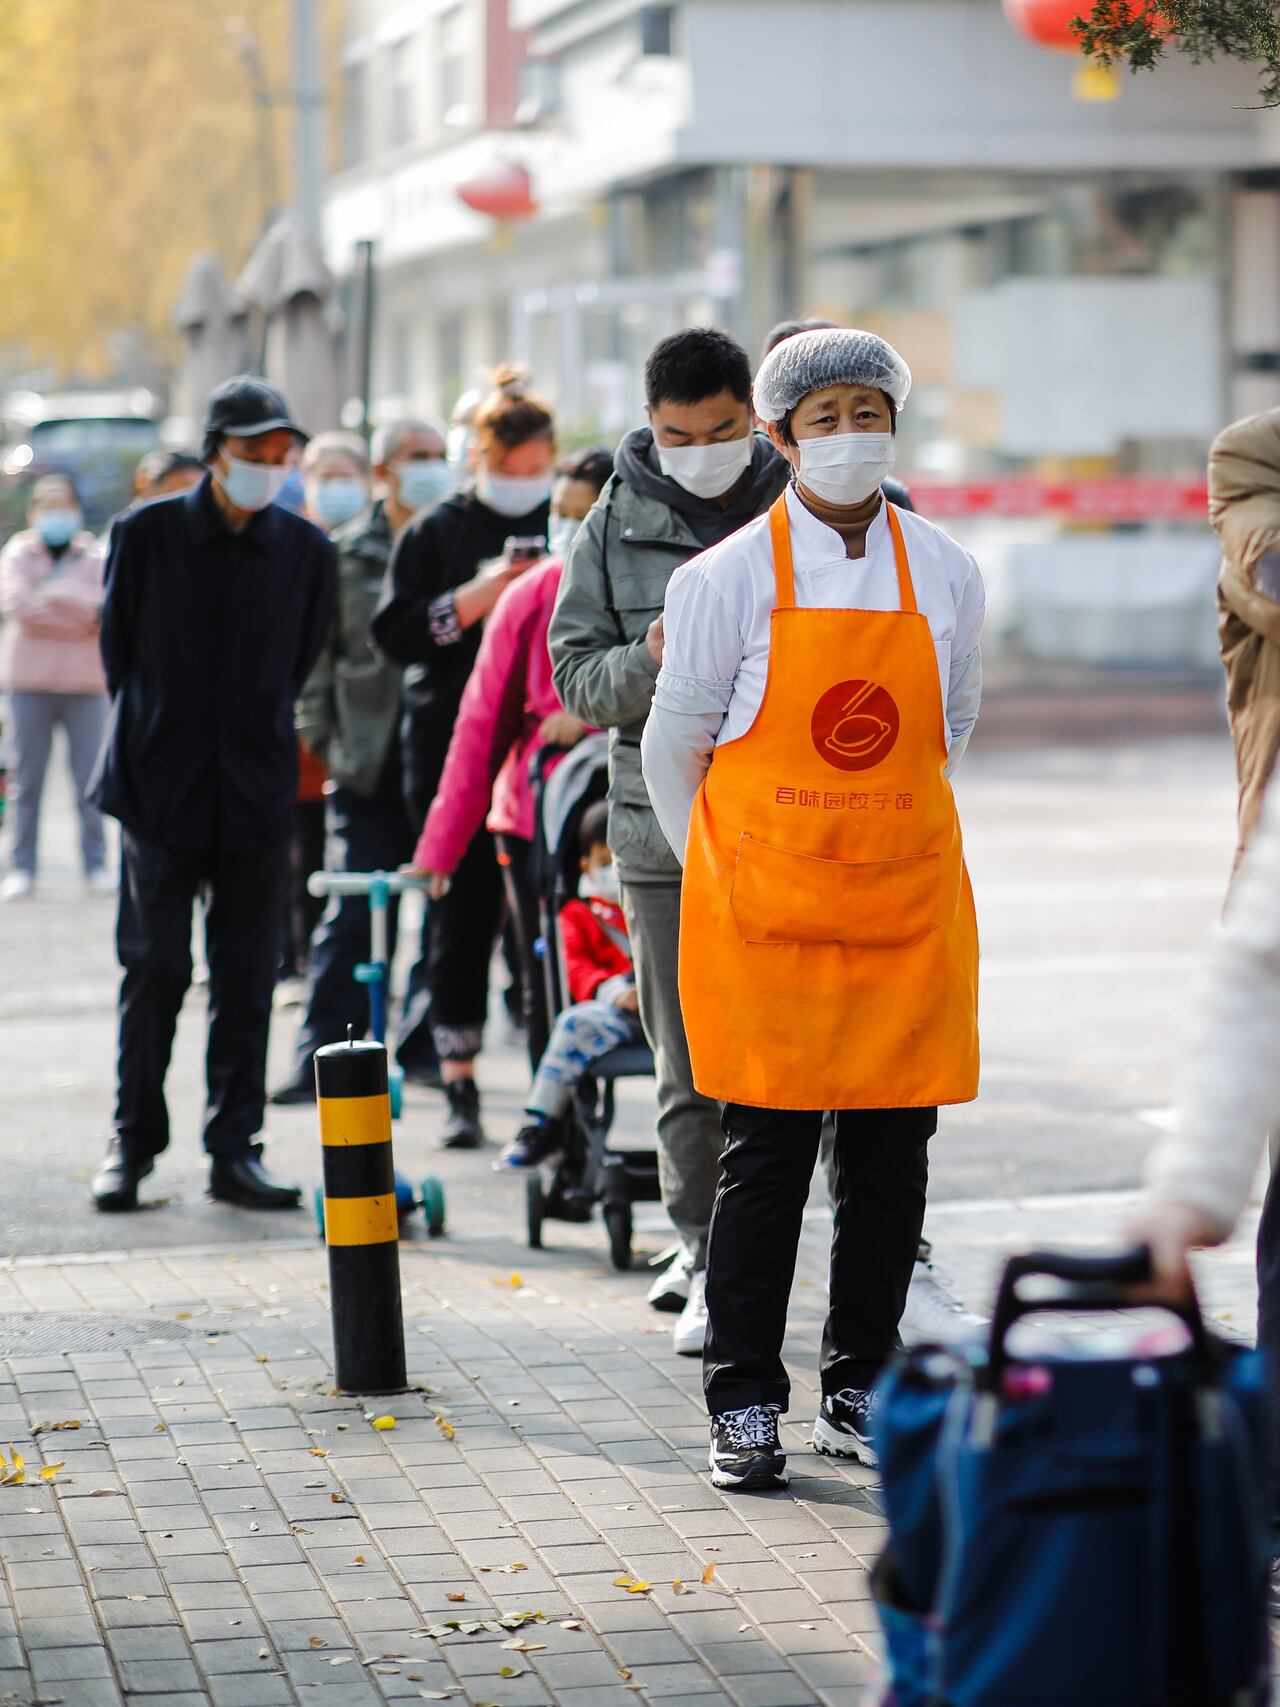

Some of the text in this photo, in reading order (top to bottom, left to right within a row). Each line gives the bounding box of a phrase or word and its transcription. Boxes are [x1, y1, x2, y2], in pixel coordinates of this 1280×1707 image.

[775, 786, 913, 810] 百味园饺子馆
